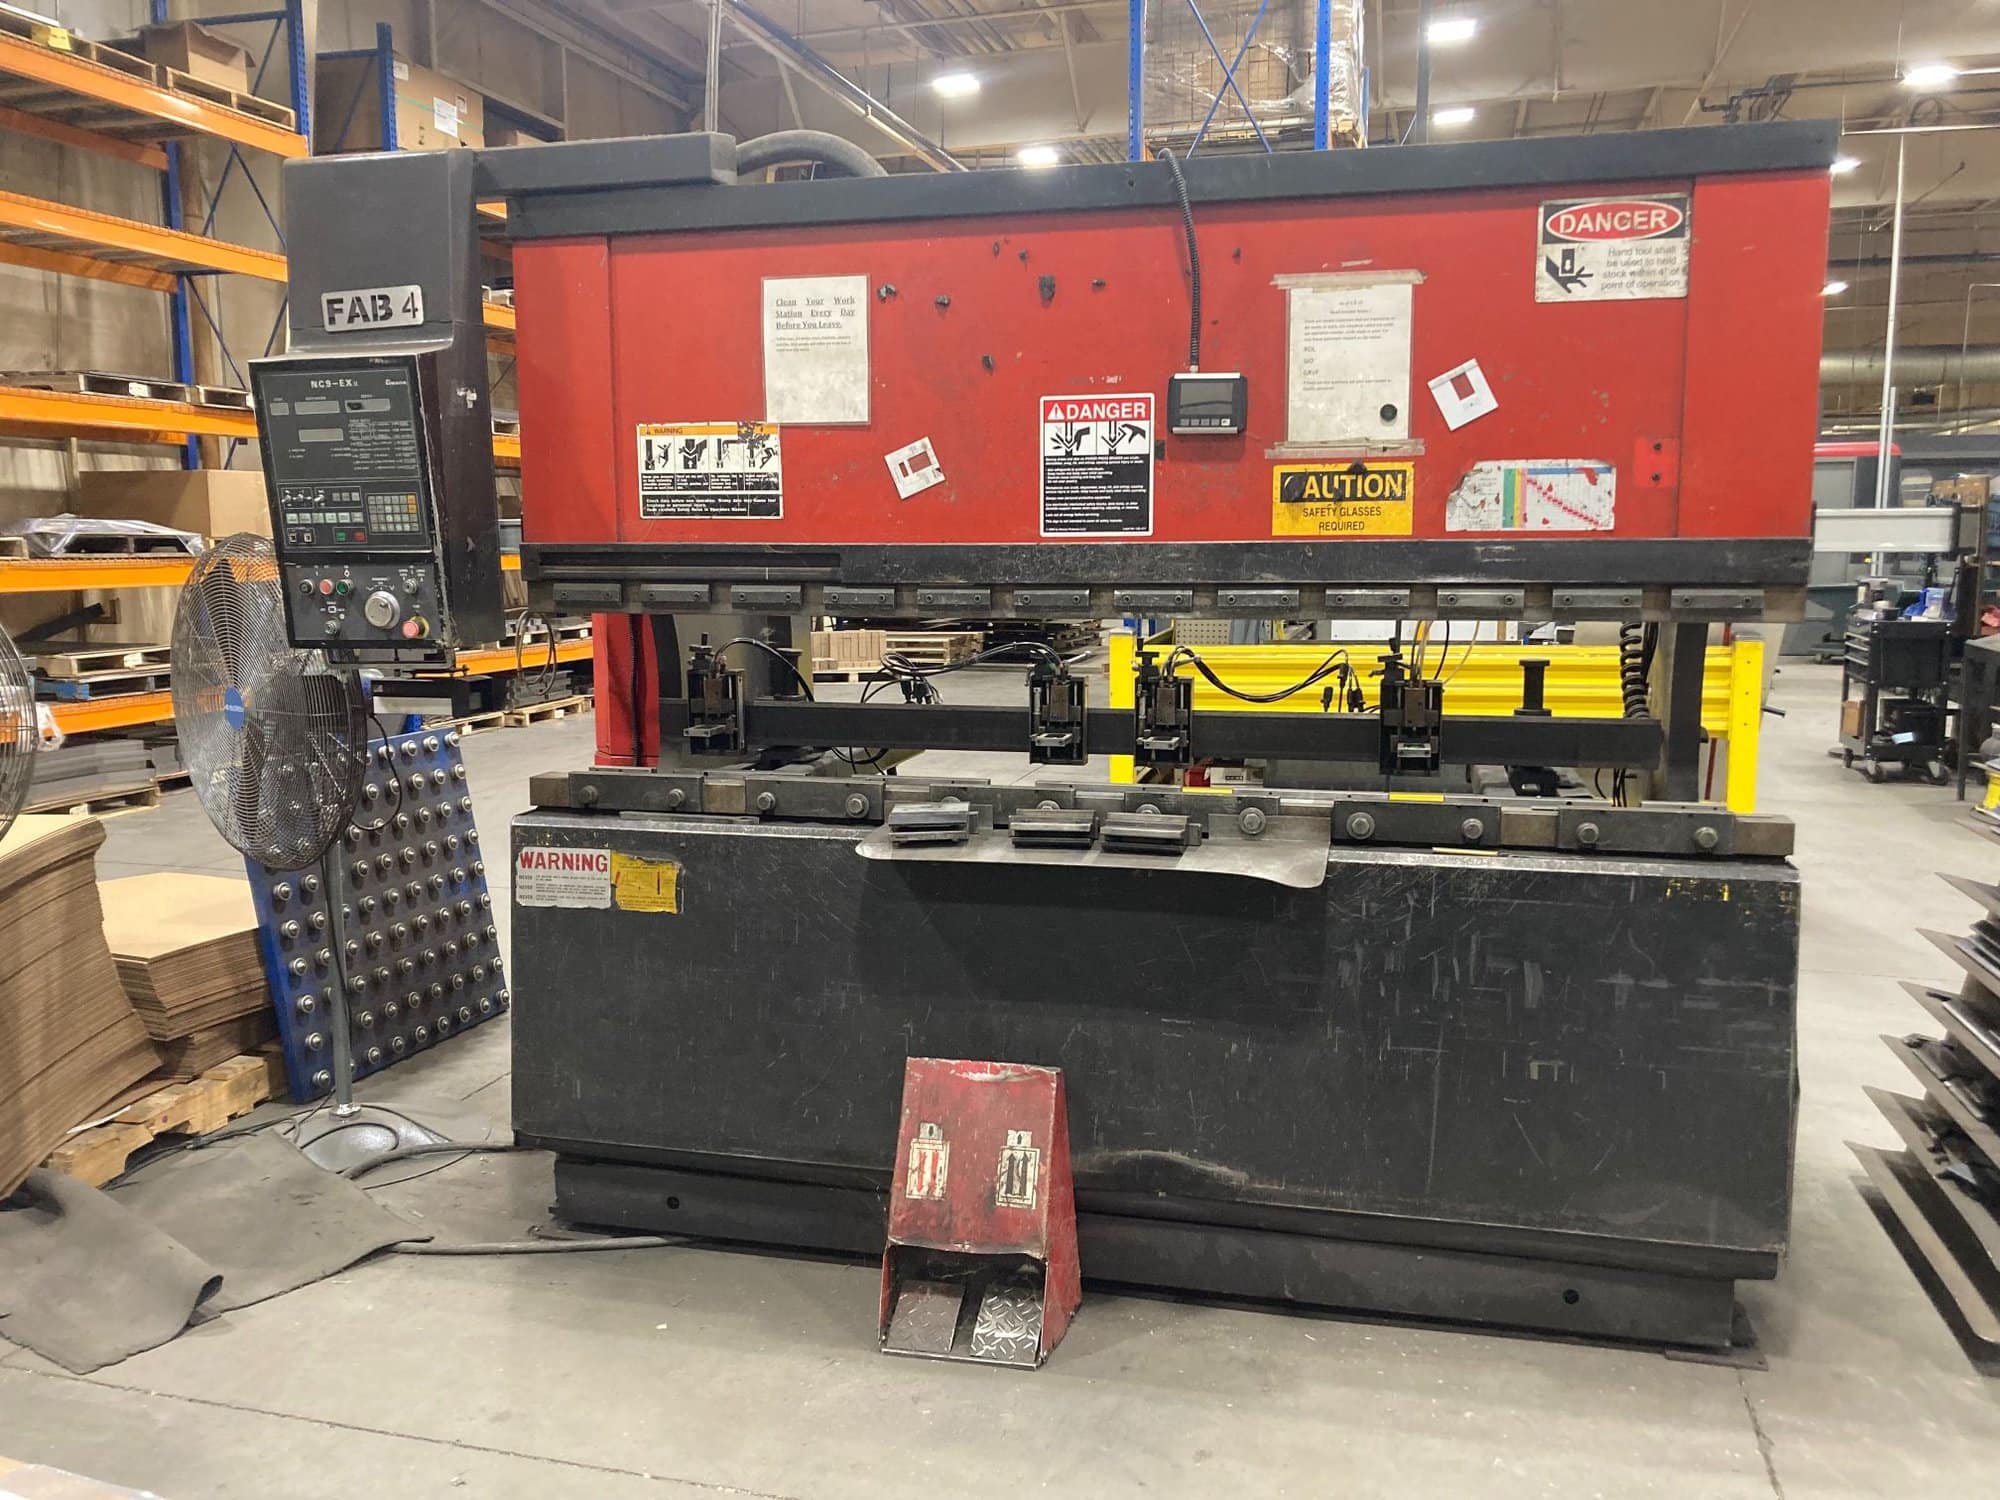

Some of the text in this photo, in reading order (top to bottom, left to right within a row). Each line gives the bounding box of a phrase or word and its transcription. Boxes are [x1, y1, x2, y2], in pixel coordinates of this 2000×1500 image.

[1559, 209, 1668, 234] DANGER
[775, 295, 855, 307] Clean Your Work
[326, 291, 418, 326] FAB 4
[775, 310, 803, 319] Station
[839, 308, 855, 317] Day
[775, 321, 801, 330] Before
[802, 320, 818, 330] You
[1066, 402, 1146, 419] DANGER
[654, 426, 684, 435] WARNING
[1303, 506, 1382, 518] SAFETY GLASSES
[1319, 521, 1365, 531] REQUIRED
[520, 851, 608, 873] WARNING
